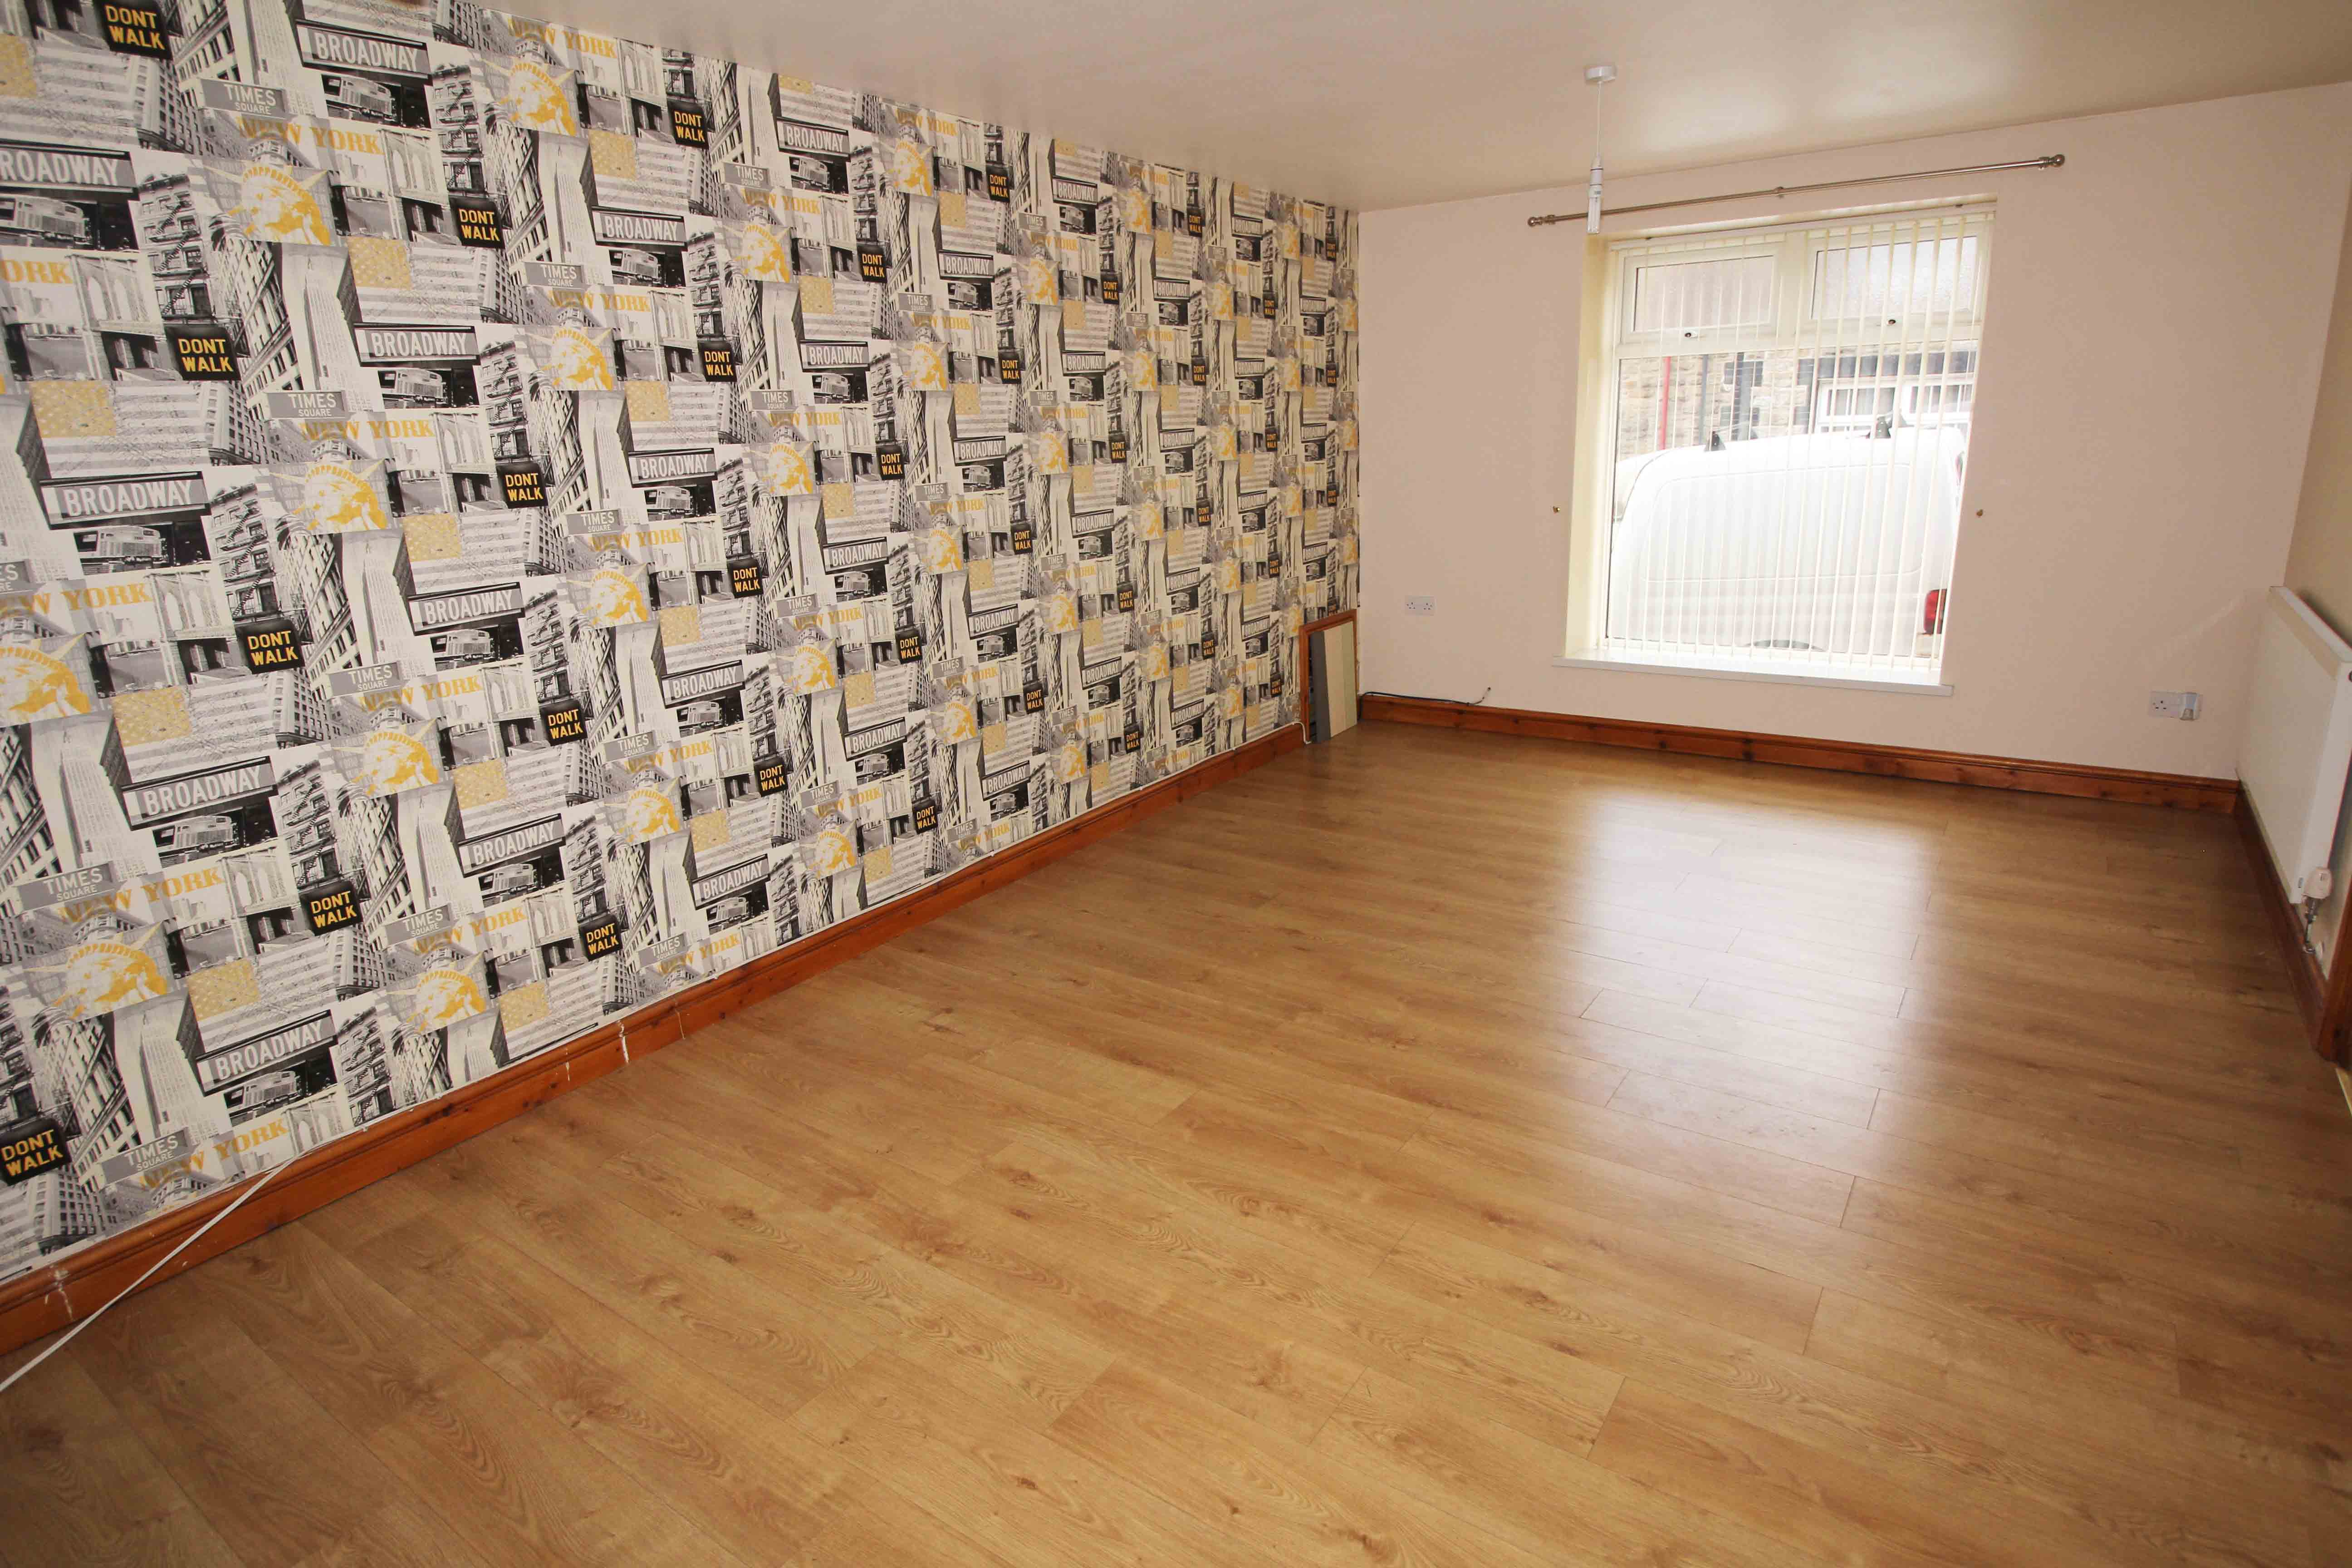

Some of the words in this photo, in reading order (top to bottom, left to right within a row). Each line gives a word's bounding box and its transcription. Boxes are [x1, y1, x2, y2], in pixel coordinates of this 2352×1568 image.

[105, 5, 157, 29] DONT
[109, 25, 165, 50] WALK
[563, 31, 617, 59] YORK
[314, 32, 418, 73] BROADWAY
[223, 83, 277, 107] TIMES
[235, 102, 272, 116] SQUARE
[674, 111, 702, 127] DONT
[311, 127, 382, 155] YORK
[676, 126, 706, 142] WALK
[787, 125, 843, 152] BROADWAY
[0, 147, 118, 186] ROADWAY
[735, 165, 764, 181] TIMES
[990, 174, 1006, 186] DONT
[990, 186, 1008, 198] WALK
[1058, 182, 1094, 202] BROADWAY
[782, 196, 821, 215] YORK
[459, 209, 495, 225] DONT
[461, 225, 500, 242] WALK
[605, 216, 677, 241] BROADWAY
[862, 254, 882, 265] DONT
[946, 256, 990, 275] BROADWAY
[0, 258, 71, 284] ORK
[540, 264, 577, 279] TIMES
[863, 265, 885, 278] WALK
[549, 279, 573, 287] SQUARE
[601, 294, 651, 312] YORK
[907, 294, 928, 306] TIMES
[1104, 291, 1118, 300] WALK
[177, 338, 226, 354] DONT
[371, 332, 466, 357] BROADWAY
[181, 357, 234, 372] WALK
[704, 351, 730, 363] DONT
[809, 346, 863, 365] BROADWAY
[1002, 360, 1018, 369] DONT
[1068, 355, 1102, 371] BROADWAY
[706, 364, 734, 376] WALK
[1003, 370, 1019, 379] WALK
[288, 393, 337, 409] TIMES
[762, 392, 789, 403] TIMES
[299, 408, 333, 417] SQUARE
[805, 412, 842, 426] YORK
[368, 420, 434, 439] YORK
[881, 453, 901, 464] DONT
[960, 441, 1002, 459] BROADWAY
[1112, 451, 1126, 459] WALK
[640, 454, 708, 479] BROADWAY
[882, 465, 903, 475] WALK
[505, 473, 538, 487] DONT
[63, 480, 192, 517] BROADWAY
[507, 487, 544, 502] WALK
[924, 484, 944, 495] TIMES
[581, 511, 615, 526] TIMES
[1078, 513, 1110, 532] BROADWAY
[588, 524, 612, 533] SQUARE
[637, 528, 683, 547] YORK
[1014, 530, 1029, 540] DONT
[1015, 540, 1031, 550] WALK
[832, 542, 882, 567] BROADWAY
[733, 567, 757, 580] DONT
[735, 579, 760, 593] WALK
[62, 583, 152, 612] YORK
[787, 596, 812, 610] TIMES
[1120, 599, 1133, 609] WALK
[424, 589, 512, 625] BROADWAY
[828, 607, 863, 625] YORK
[975, 608, 1014, 632] BROADWAY
[247, 630, 291, 650] DONT
[900, 636, 918, 649] DONT
[250, 647, 299, 666] WALK
[901, 647, 921, 659] WALK
[940, 659, 960, 671] TIMES
[1087, 661, 1119, 683] BROADWAY
[348, 665, 393, 685] TIMES
[673, 666, 736, 699] BROADWAY
[358, 679, 389, 691] SQUARE
[421, 675, 482, 701] YORK
[1027, 689, 1041, 701] DONT
[1027, 698, 1043, 710] WALK
[548, 709, 578, 726] DONT
[550, 722, 583, 740] WALK
[853, 722, 901, 753] BROADWAY
[617, 734, 649, 752] TIMES
[624, 746, 646, 757] SQUARE
[669, 740, 713, 763] YORK
[1127, 739, 1139, 750] WALK
[760, 764, 783, 780] DONT
[988, 765, 1026, 794] BROADWAY
[143, 765, 260, 816] BROADWAY
[761, 776, 786, 791] WALK
[810, 784, 834, 799] TIMES
[849, 786, 882, 808] YORK
[916, 806, 934, 820] DONT
[917, 815, 936, 830] WALK
[955, 821, 973, 835] TIMES
[473, 821, 554, 866] BROADWAY
[42, 867, 103, 895] TIMES
[142, 867, 224, 903] YORK
[703, 860, 762, 900] BROADWAY
[57, 884, 98, 901] SQUARE
[310, 890, 351, 914] DONT
[314, 905, 358, 928] WALK
[402, 909, 444, 932] TIMES
[470, 906, 526, 937] YORK
[412, 922, 440, 937] SQUARE
[586, 923, 615, 943] DONT
[588, 935, 619, 955] WALK
[651, 937, 681, 956] TIMES
[699, 933, 740, 960] YORK
[657, 948, 678, 961] SQUARE
[216, 1019, 322, 1081] BROADWAY
[0, 1128, 55, 1161] DONT
[214, 1119, 288, 1161] YORK
[124, 1136, 179, 1166] TIMES
[5, 1145, 64, 1176] WALK
[137, 1150, 175, 1171] SQUARE
